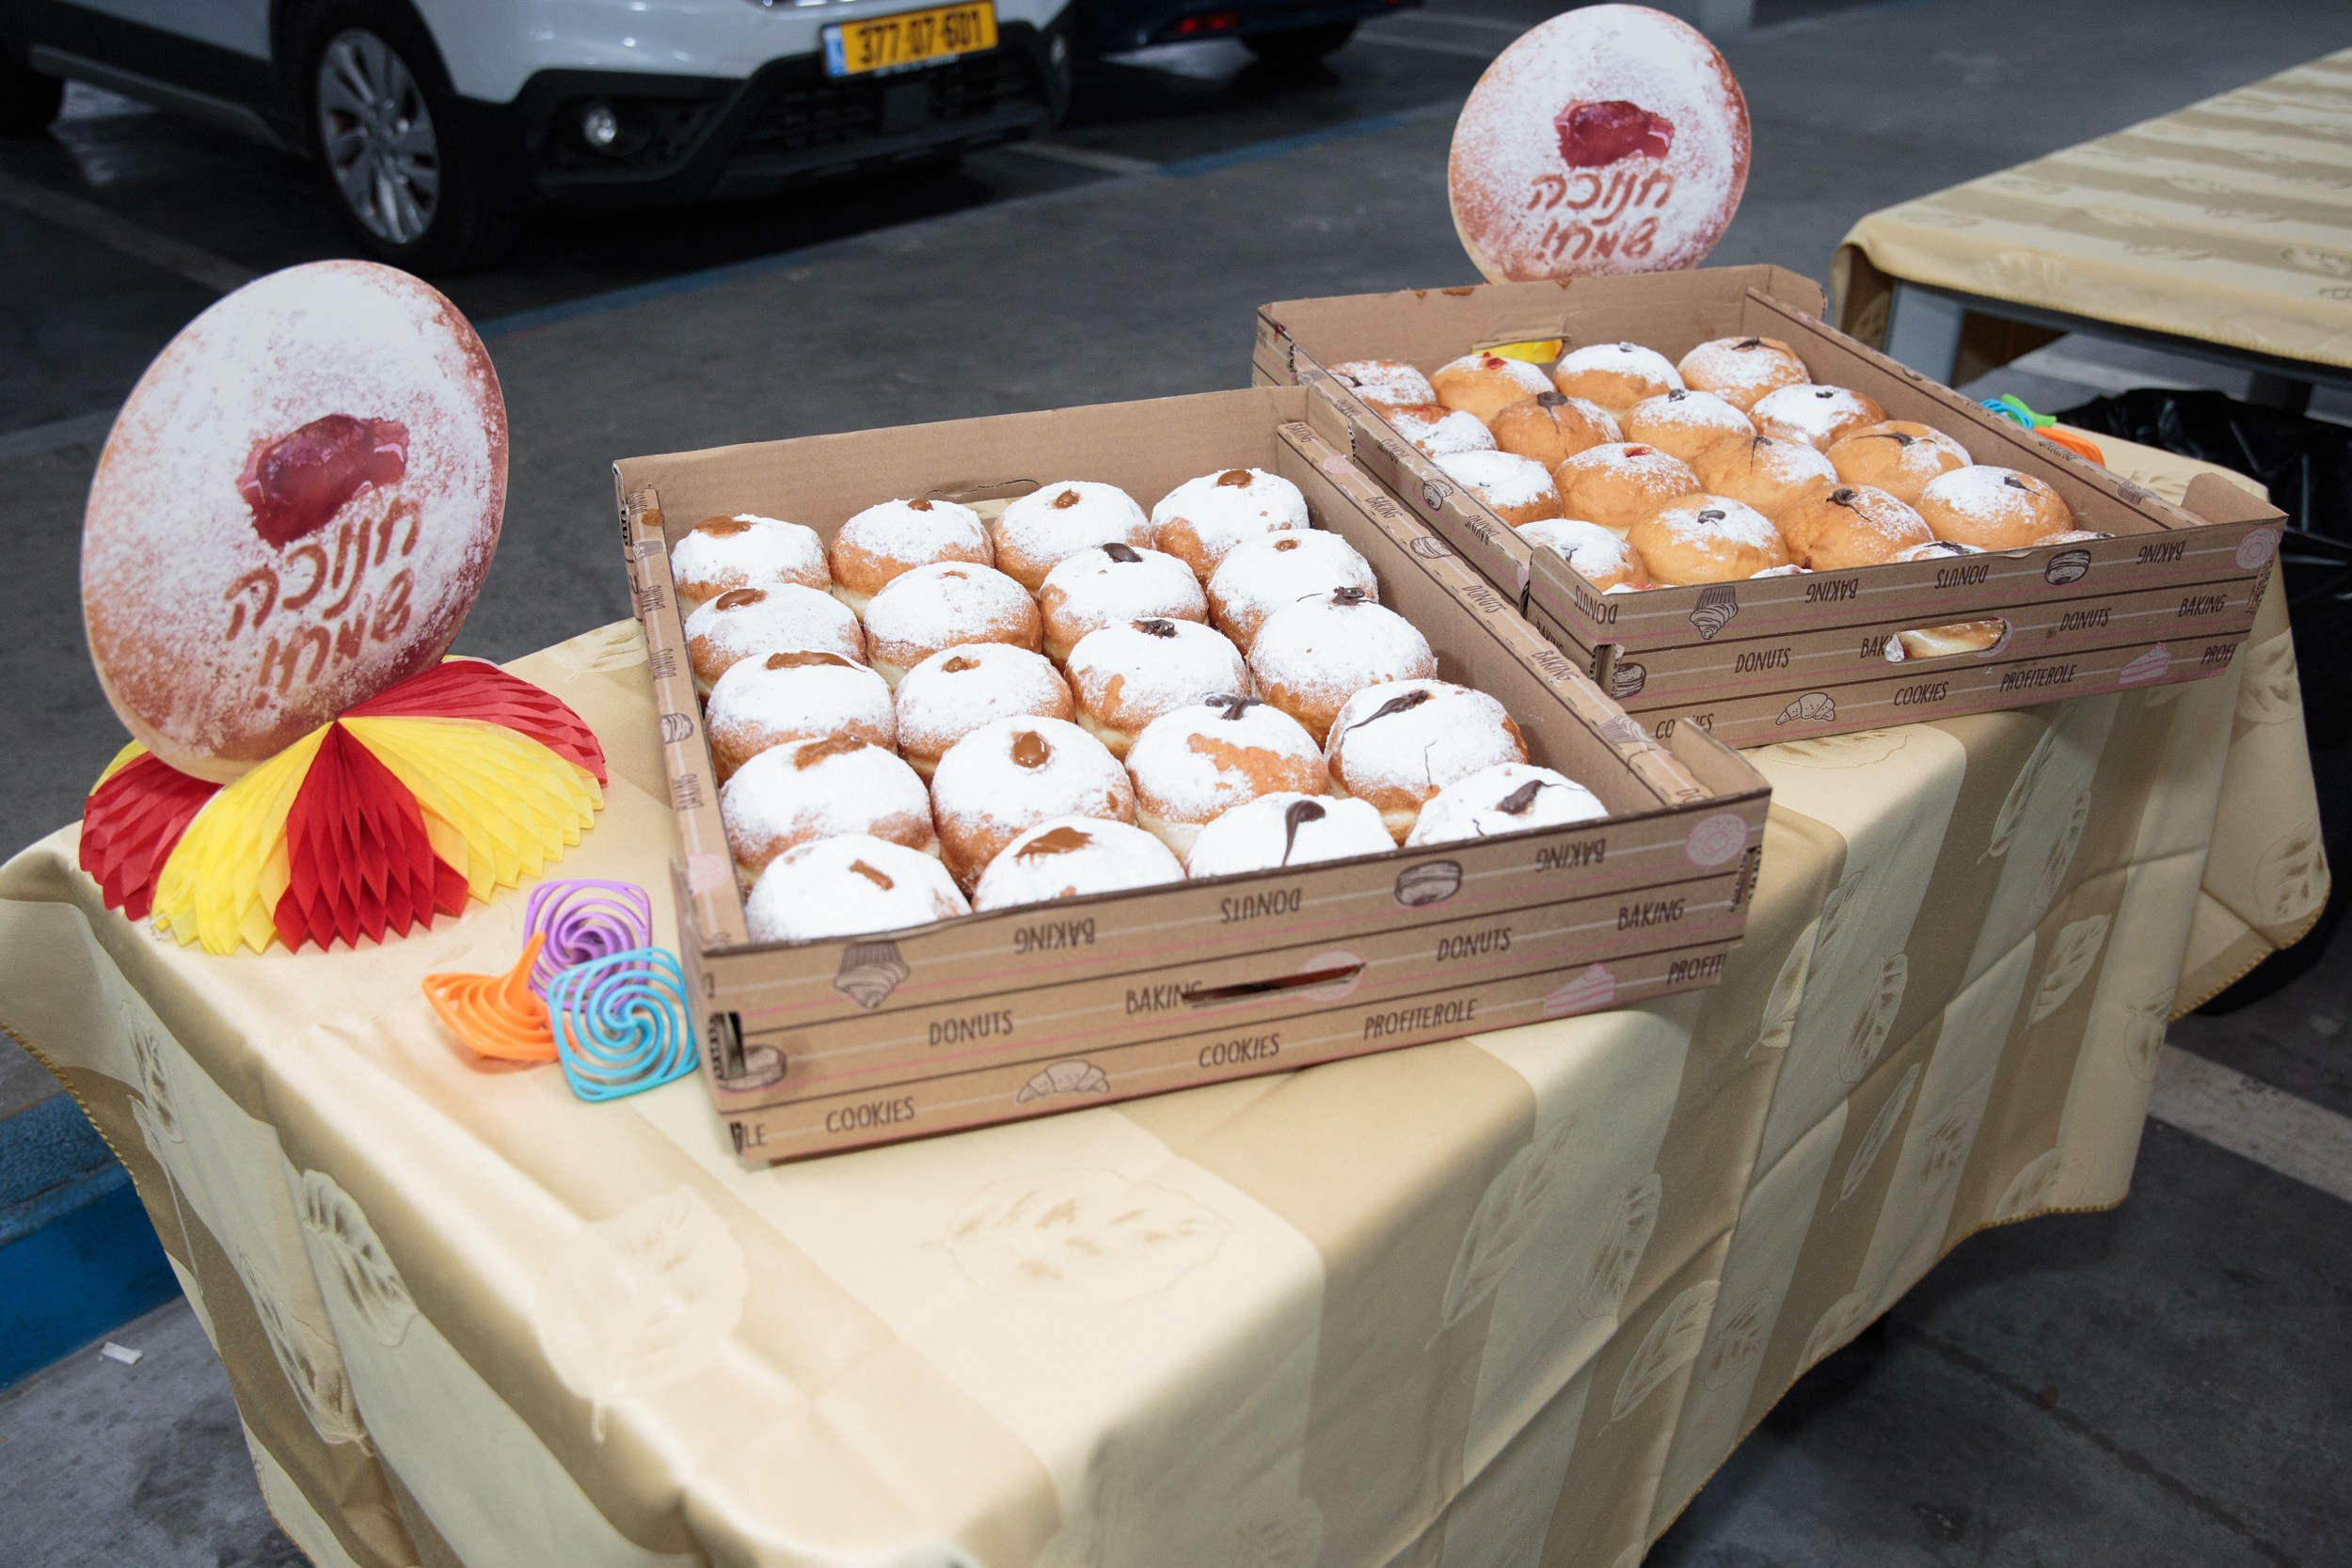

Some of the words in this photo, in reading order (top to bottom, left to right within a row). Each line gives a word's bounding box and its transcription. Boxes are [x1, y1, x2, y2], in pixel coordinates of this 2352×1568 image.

[858, 23, 899, 65] 377
[1527, 168, 1675, 226] חנוכה
[1535, 215, 1660, 261] שמח!
[224, 497, 421, 641] חנוכה
[1285, 423, 1318, 443] BAKING
[1365, 496, 1403, 518] BAKING
[1462, 585, 1507, 613] DONUTS
[1531, 650, 1580, 681] BAKING
[2137, 540, 2187, 565] BAKING
[1804, 578, 1859, 604] BAKING
[1934, 564, 1990, 590] DONUTS
[1574, 584, 1619, 625] DONUTS
[254, 568, 414, 709] שמח!
[1735, 647, 1791, 673] DONUTS
[1860, 634, 1893, 658] BAK
[2059, 607, 2112, 632] DONUTS
[2178, 594, 2227, 617] BAKING
[1894, 681, 1949, 707] COOKIES
[1999, 664, 2078, 693] PROFITEROLE
[1535, 838, 1606, 873] BAKING
[1219, 887, 1302, 925] DONUTS
[1014, 917, 1096, 955] BAKING
[929, 1010, 1014, 1047] DONUTS
[1436, 927, 1512, 961] DONUTS
[1616, 898, 1686, 930] BAKING
[825, 1097, 915, 1133] COOKIES
[1199, 1034, 1280, 1068] COOKIES
[1363, 998, 1478, 1040] PROFITEROLE
[1666, 950, 1727, 985] PROFIT
